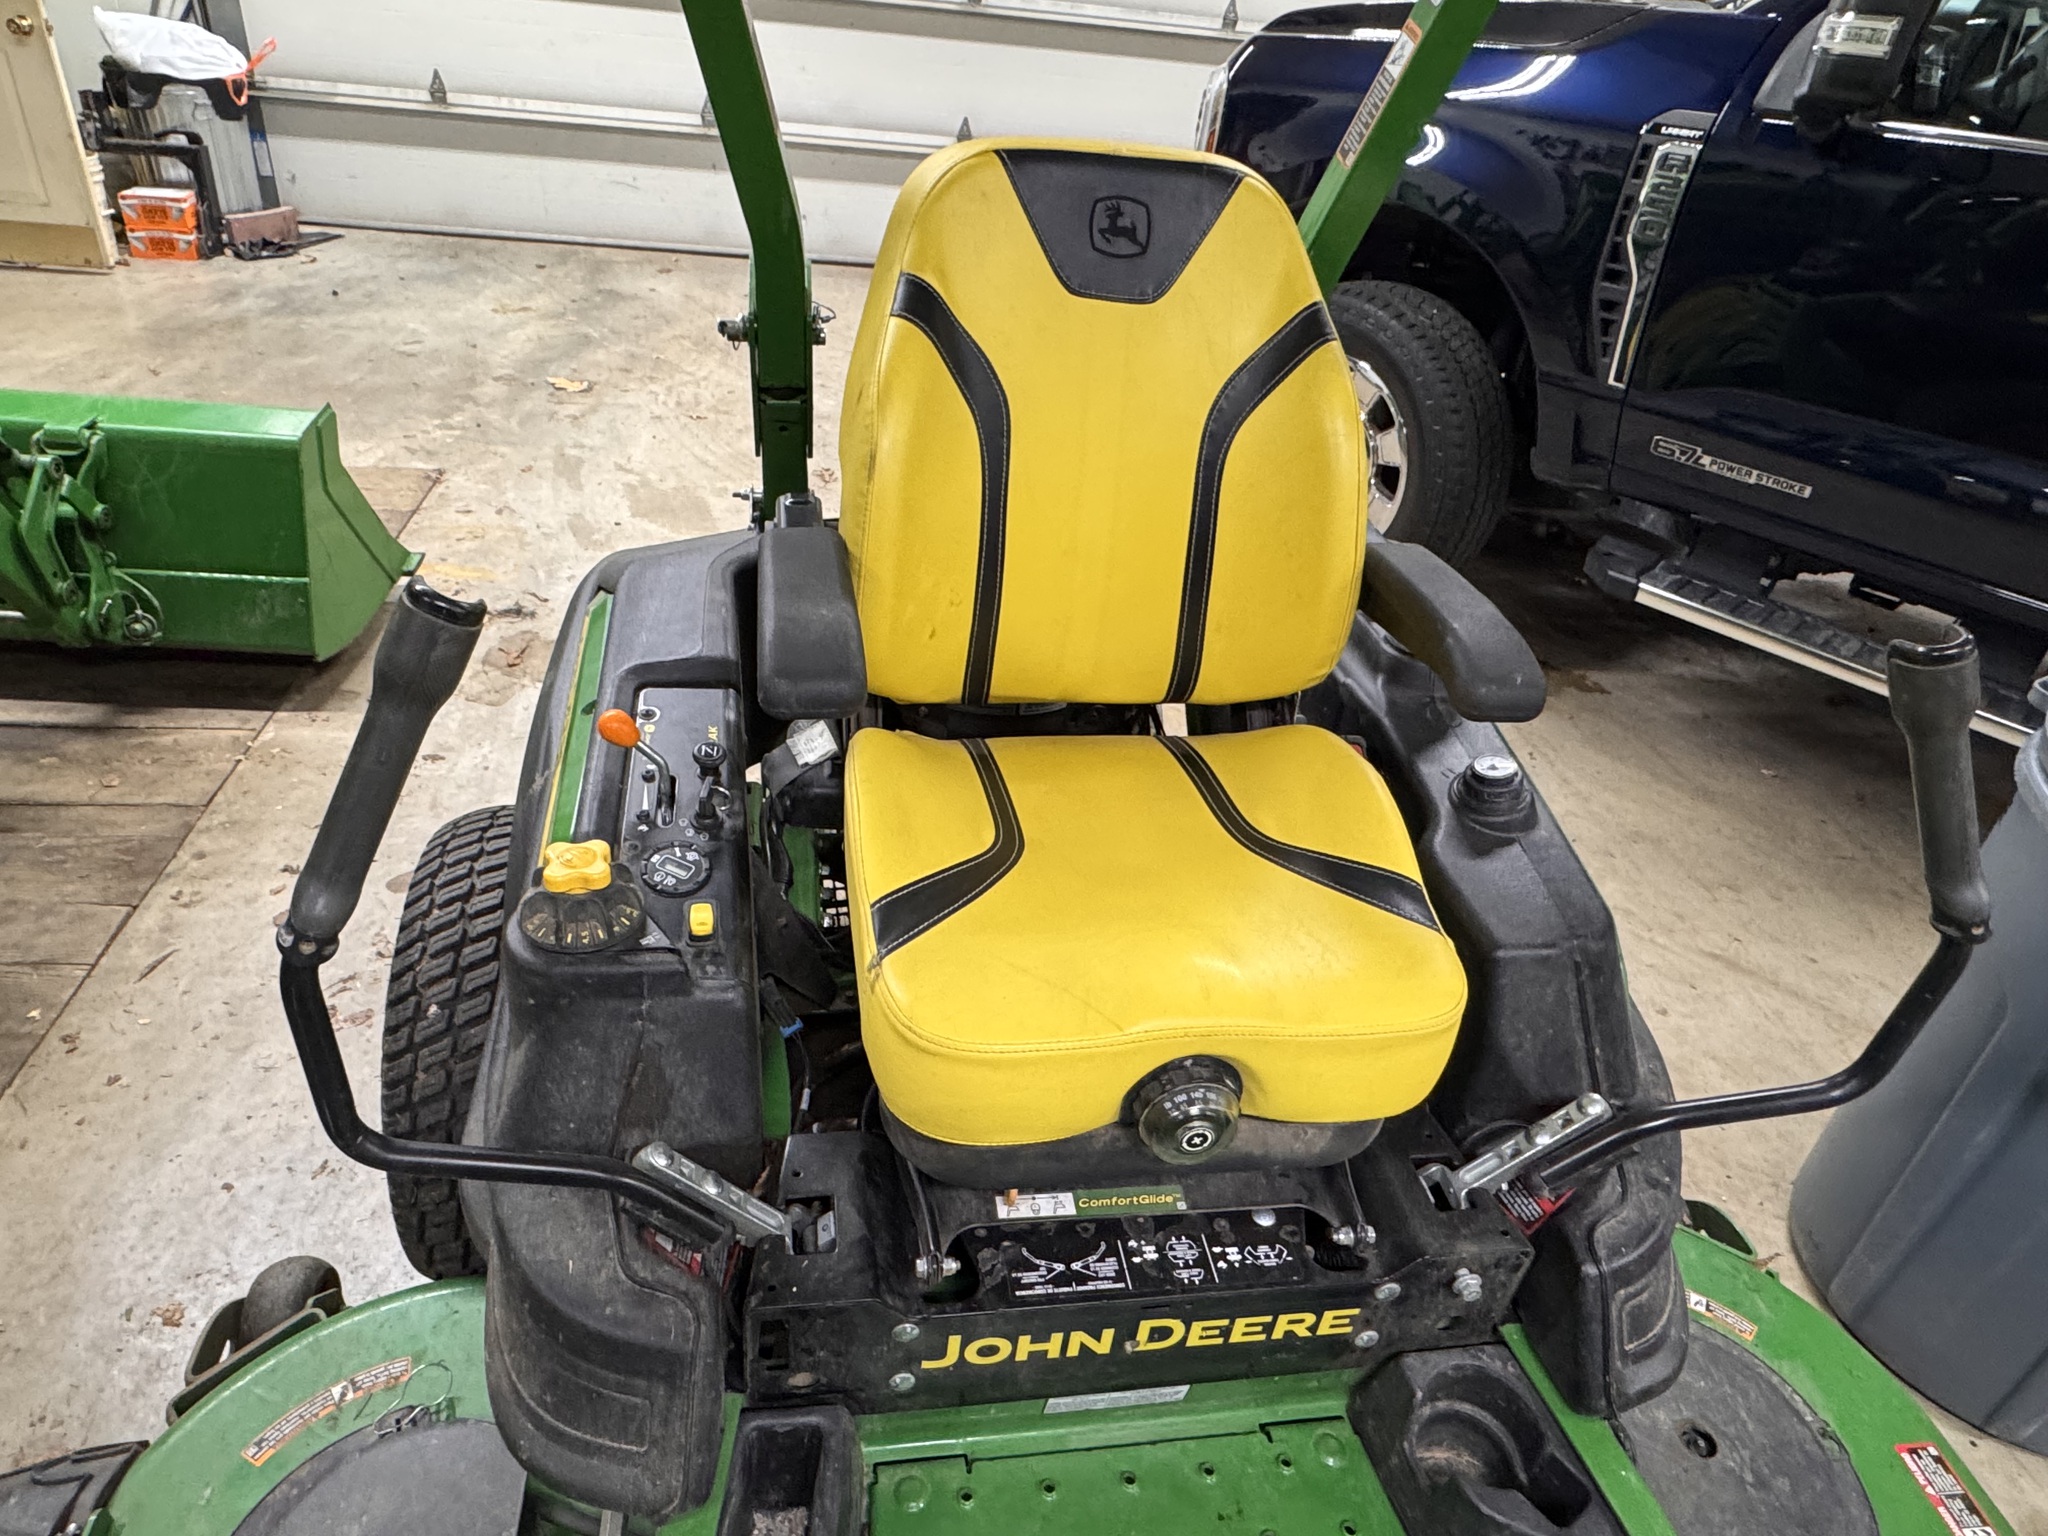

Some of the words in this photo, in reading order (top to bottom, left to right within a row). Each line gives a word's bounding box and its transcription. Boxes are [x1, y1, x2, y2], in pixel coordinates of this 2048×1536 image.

[1709, 458, 1753, 480] POWER
[1756, 473, 1807, 496] STROKE
[1173, 1093, 1188, 1104] 100
[921, 1328, 1115, 1369] JOHN
[1133, 1308, 1361, 1352] DEERE
